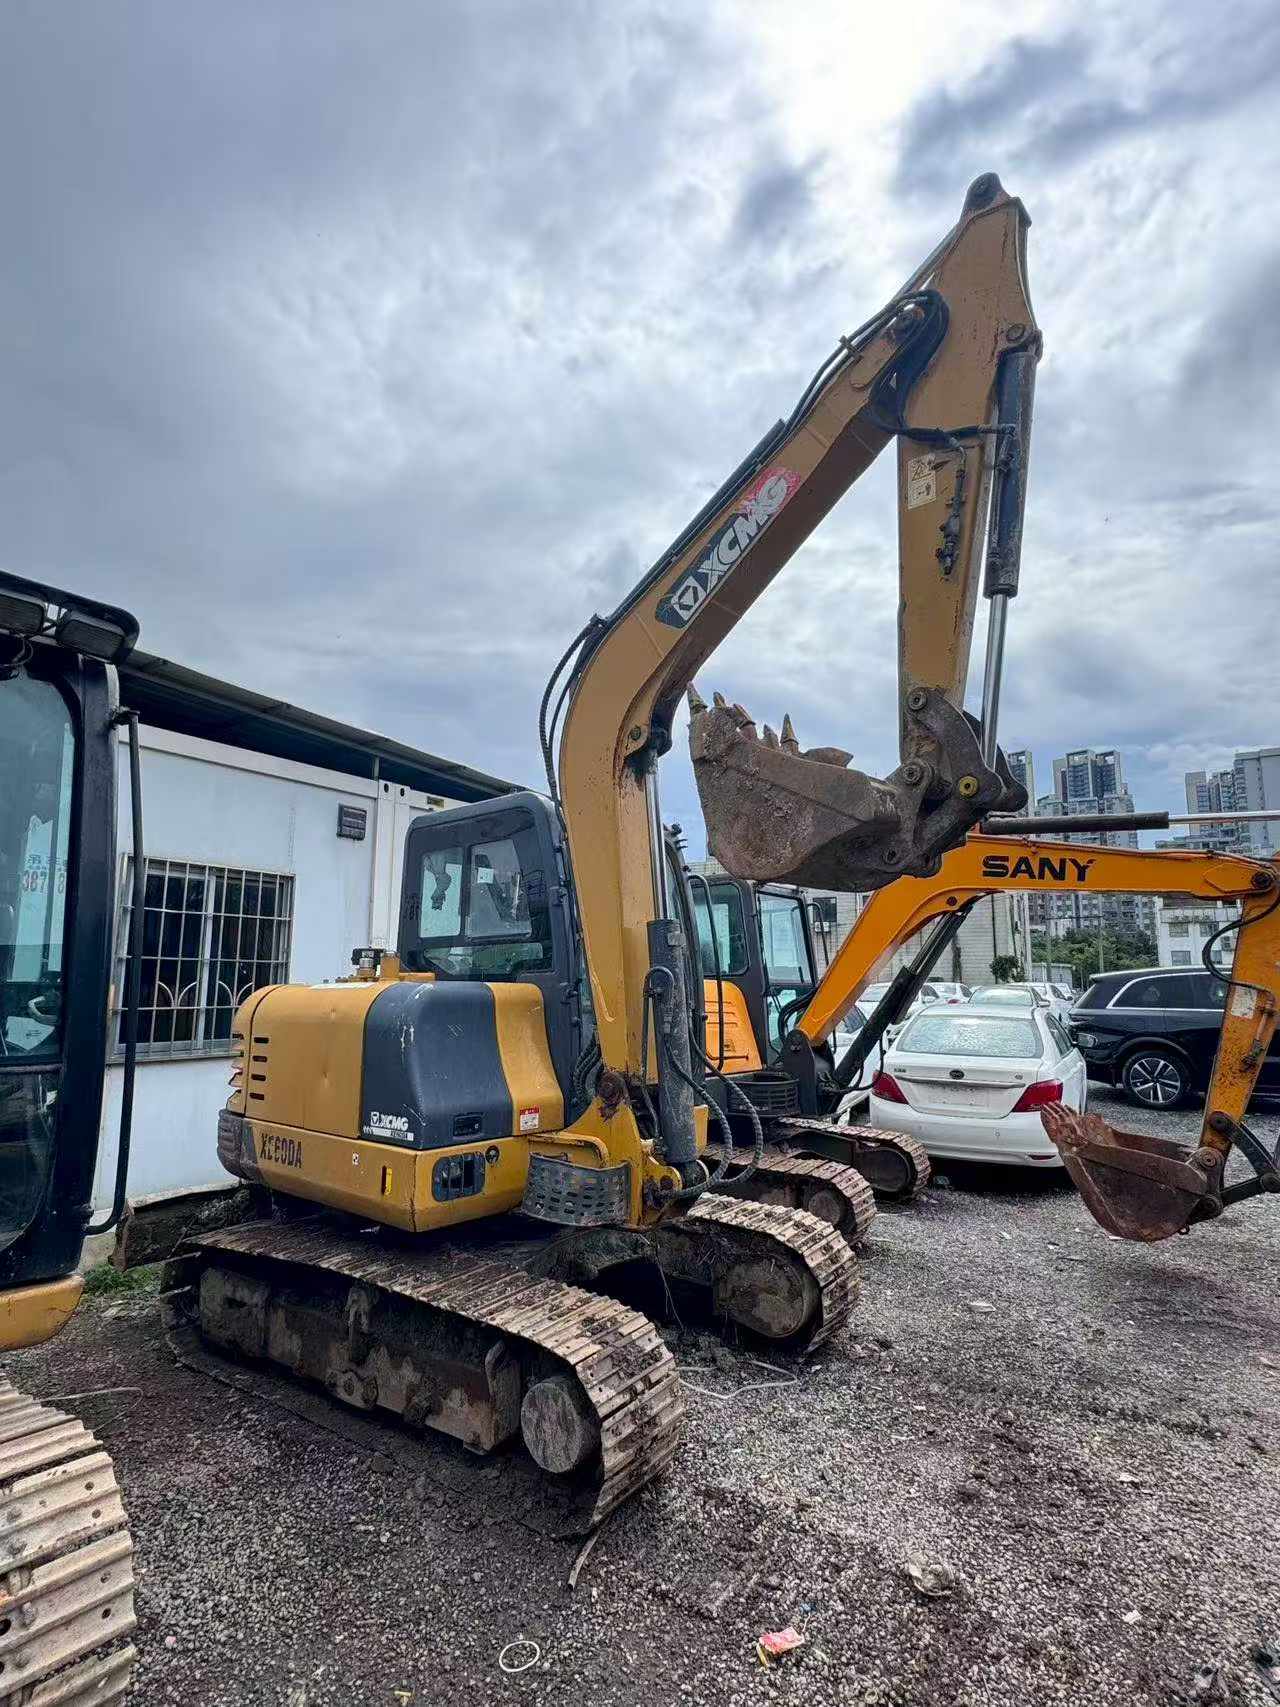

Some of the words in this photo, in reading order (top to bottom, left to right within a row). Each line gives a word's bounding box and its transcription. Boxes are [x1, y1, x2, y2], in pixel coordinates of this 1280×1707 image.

[697, 475, 789, 595] XCMG
[982, 855, 1097, 882] SANY
[380, 1113, 409, 1132] XCMG
